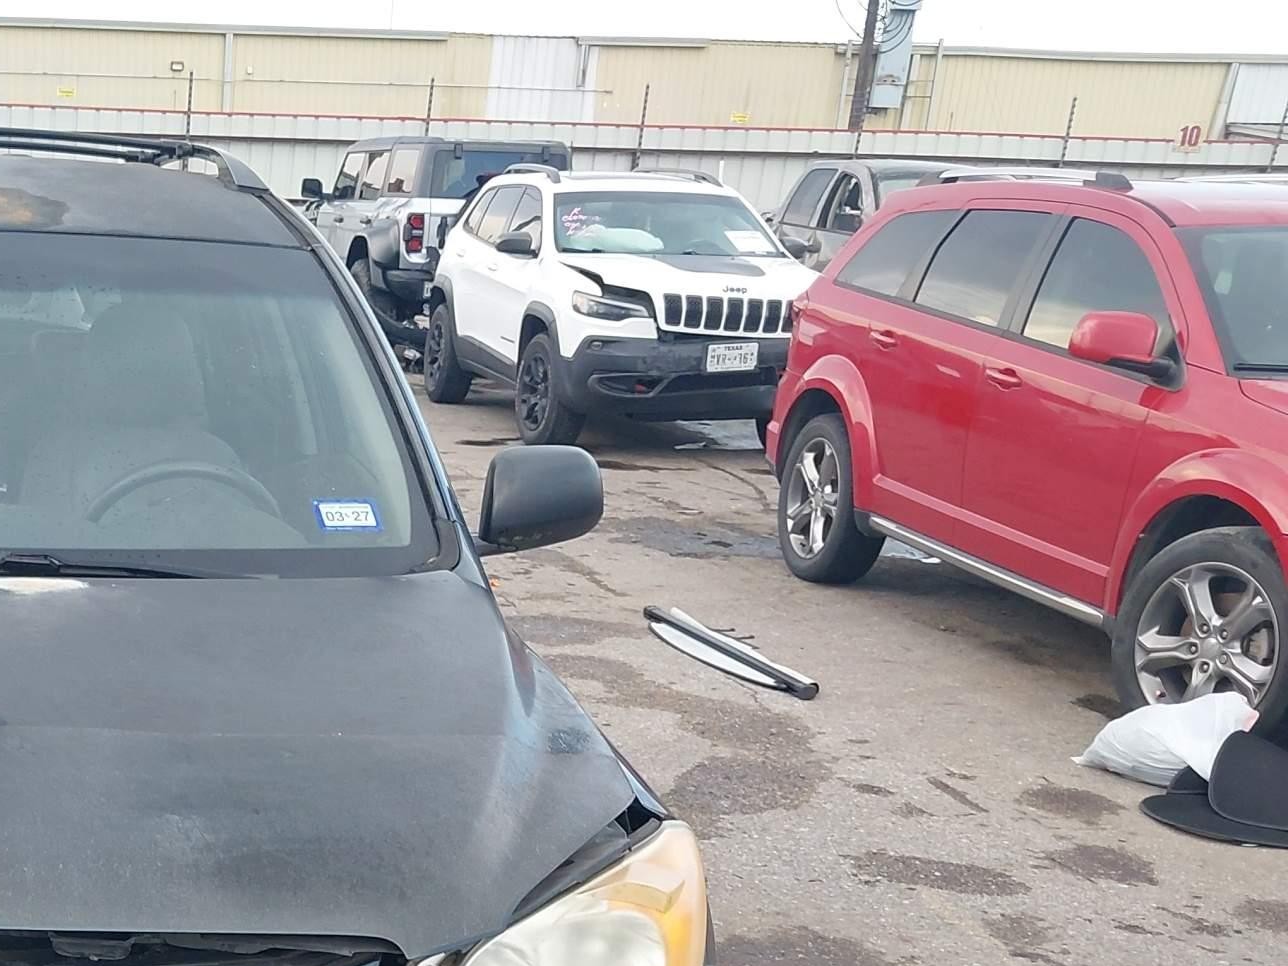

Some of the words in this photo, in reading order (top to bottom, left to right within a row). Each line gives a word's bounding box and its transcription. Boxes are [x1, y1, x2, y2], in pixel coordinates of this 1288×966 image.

[1180, 125, 1202, 147] 10
[722, 285, 748, 295] Jeep
[325, 511, 345, 522] 03
[352, 510, 369, 522] 27
